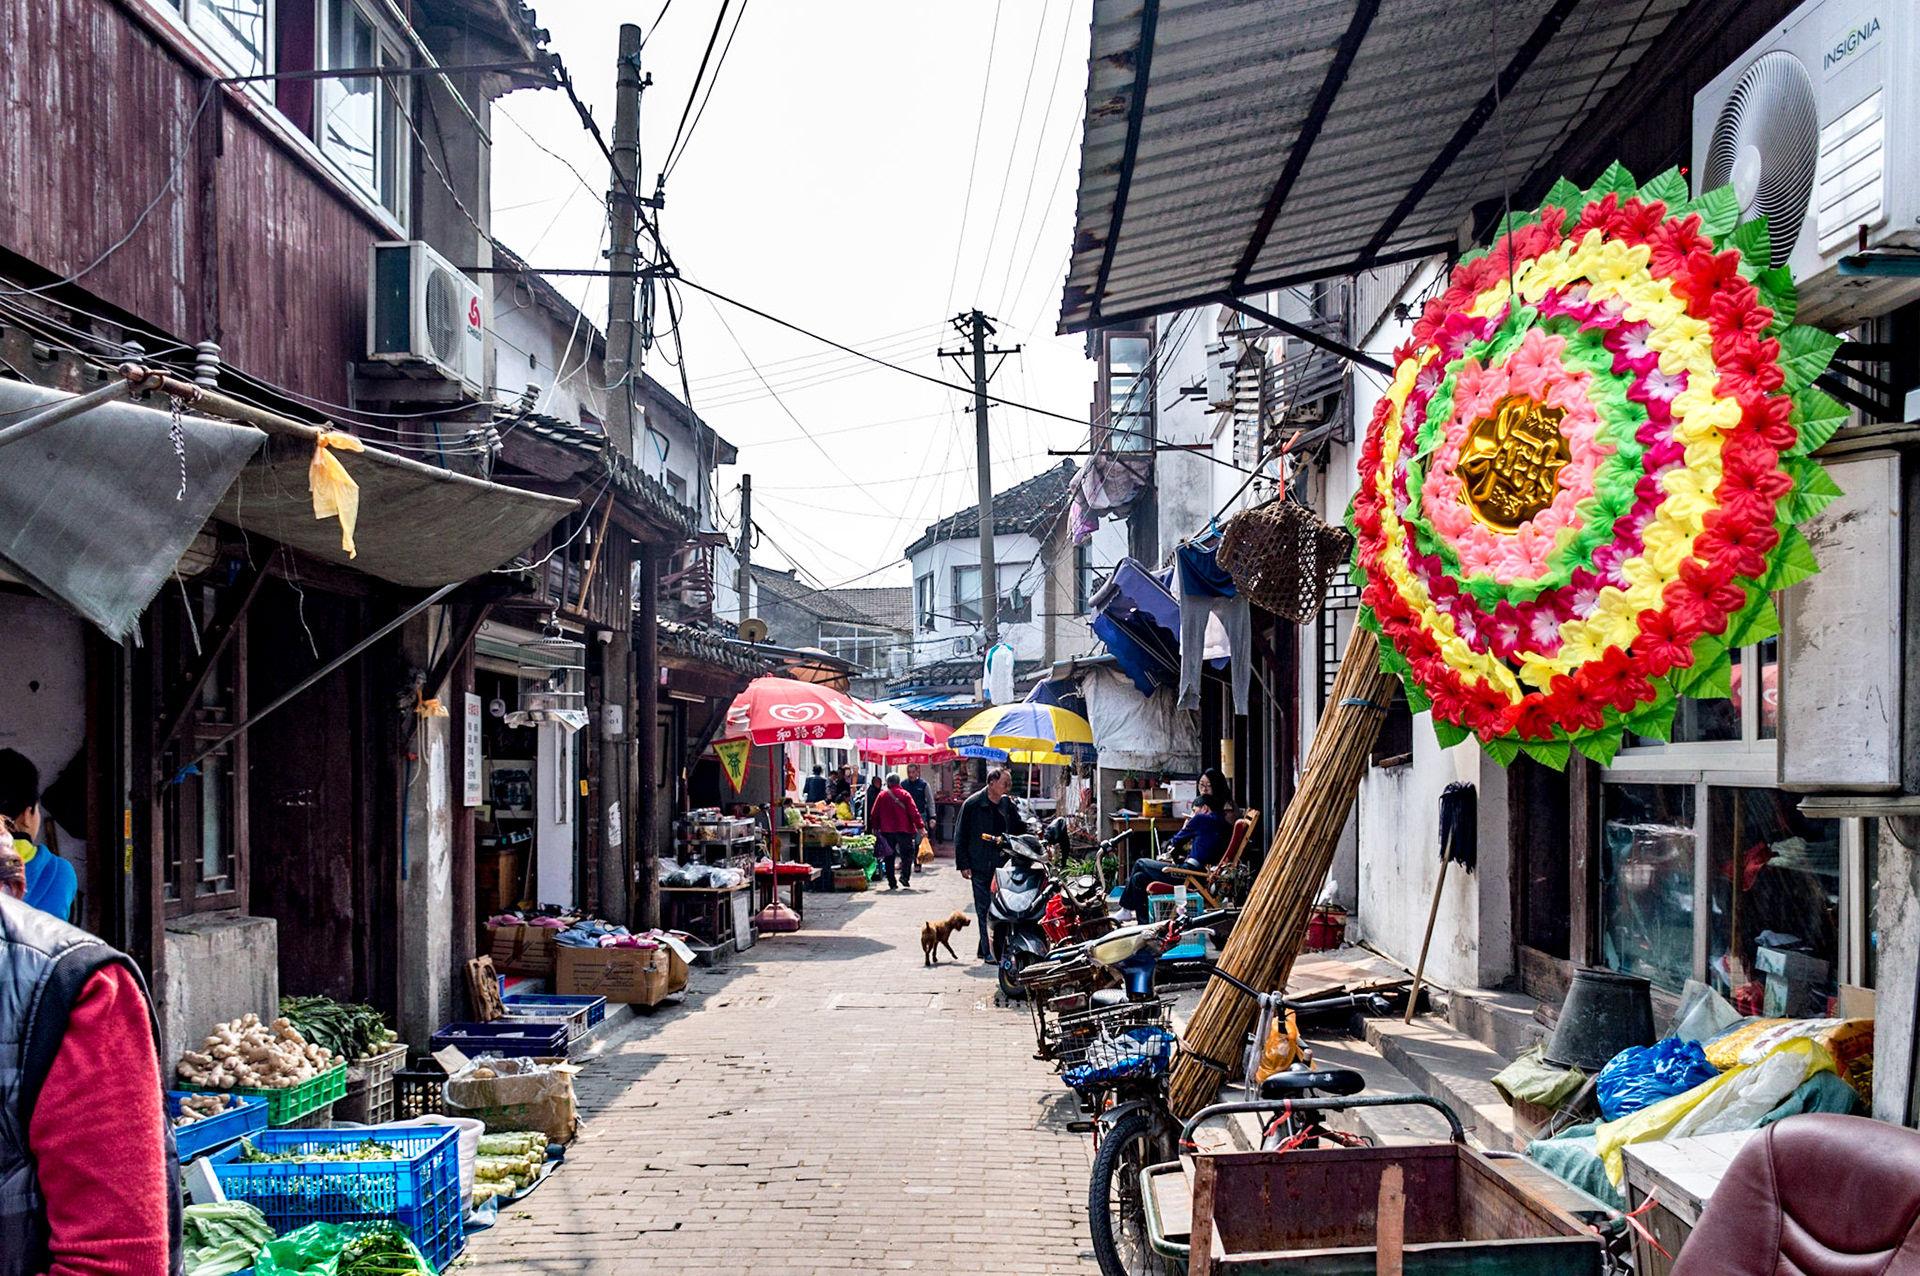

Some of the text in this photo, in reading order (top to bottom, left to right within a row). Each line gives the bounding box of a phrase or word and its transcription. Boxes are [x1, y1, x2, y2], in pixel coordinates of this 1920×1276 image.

[1823, 17, 1881, 71] INSIGNIA
[776, 725, 826, 741] 和路雪
